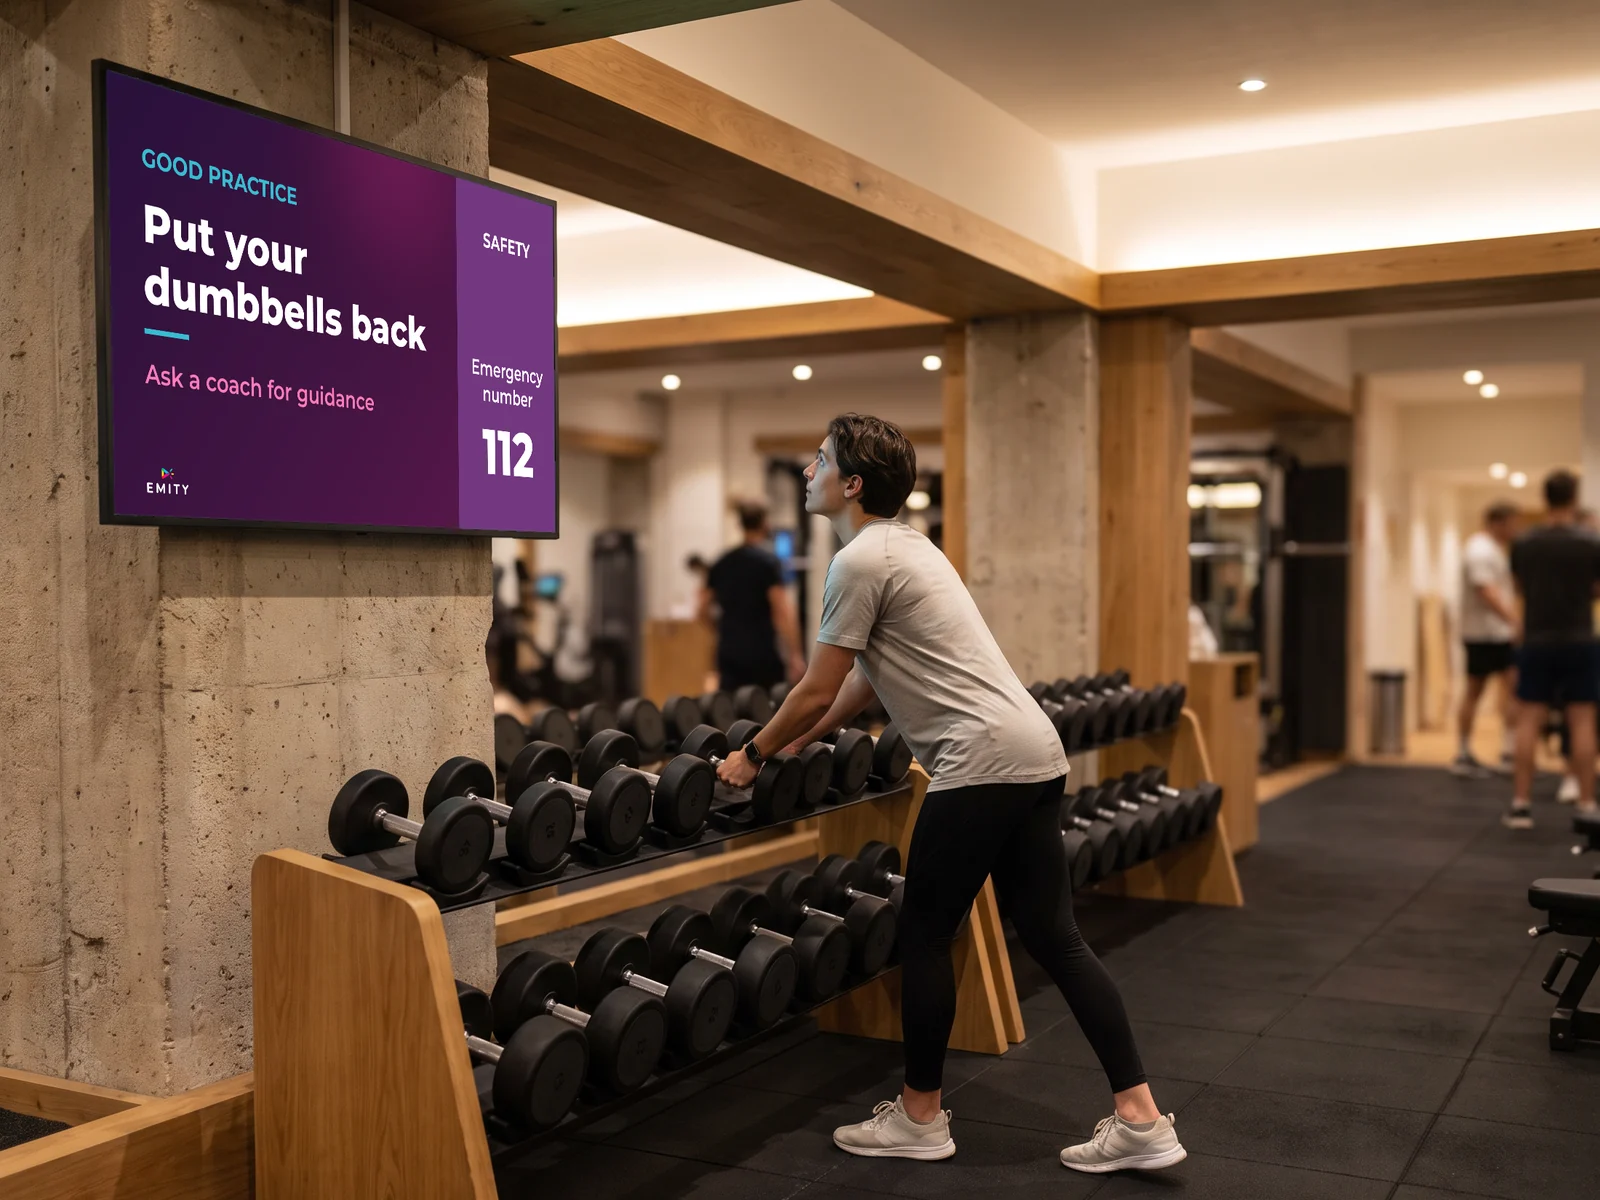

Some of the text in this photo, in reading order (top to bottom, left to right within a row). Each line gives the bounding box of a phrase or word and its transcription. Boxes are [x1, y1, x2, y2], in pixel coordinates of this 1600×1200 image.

[141, 148, 298, 206] GOOD PRACTICE
[144, 203, 308, 276] Put your
[482, 232, 531, 260] SAFETY
[143, 266, 428, 352] dumbbells back
[145, 364, 376, 412] Ask a coach for guidance
[471, 357, 544, 389] Emergency
[482, 388, 534, 409] number
[481, 428, 534, 479] 112
[146, 481, 191, 496] EMITY
